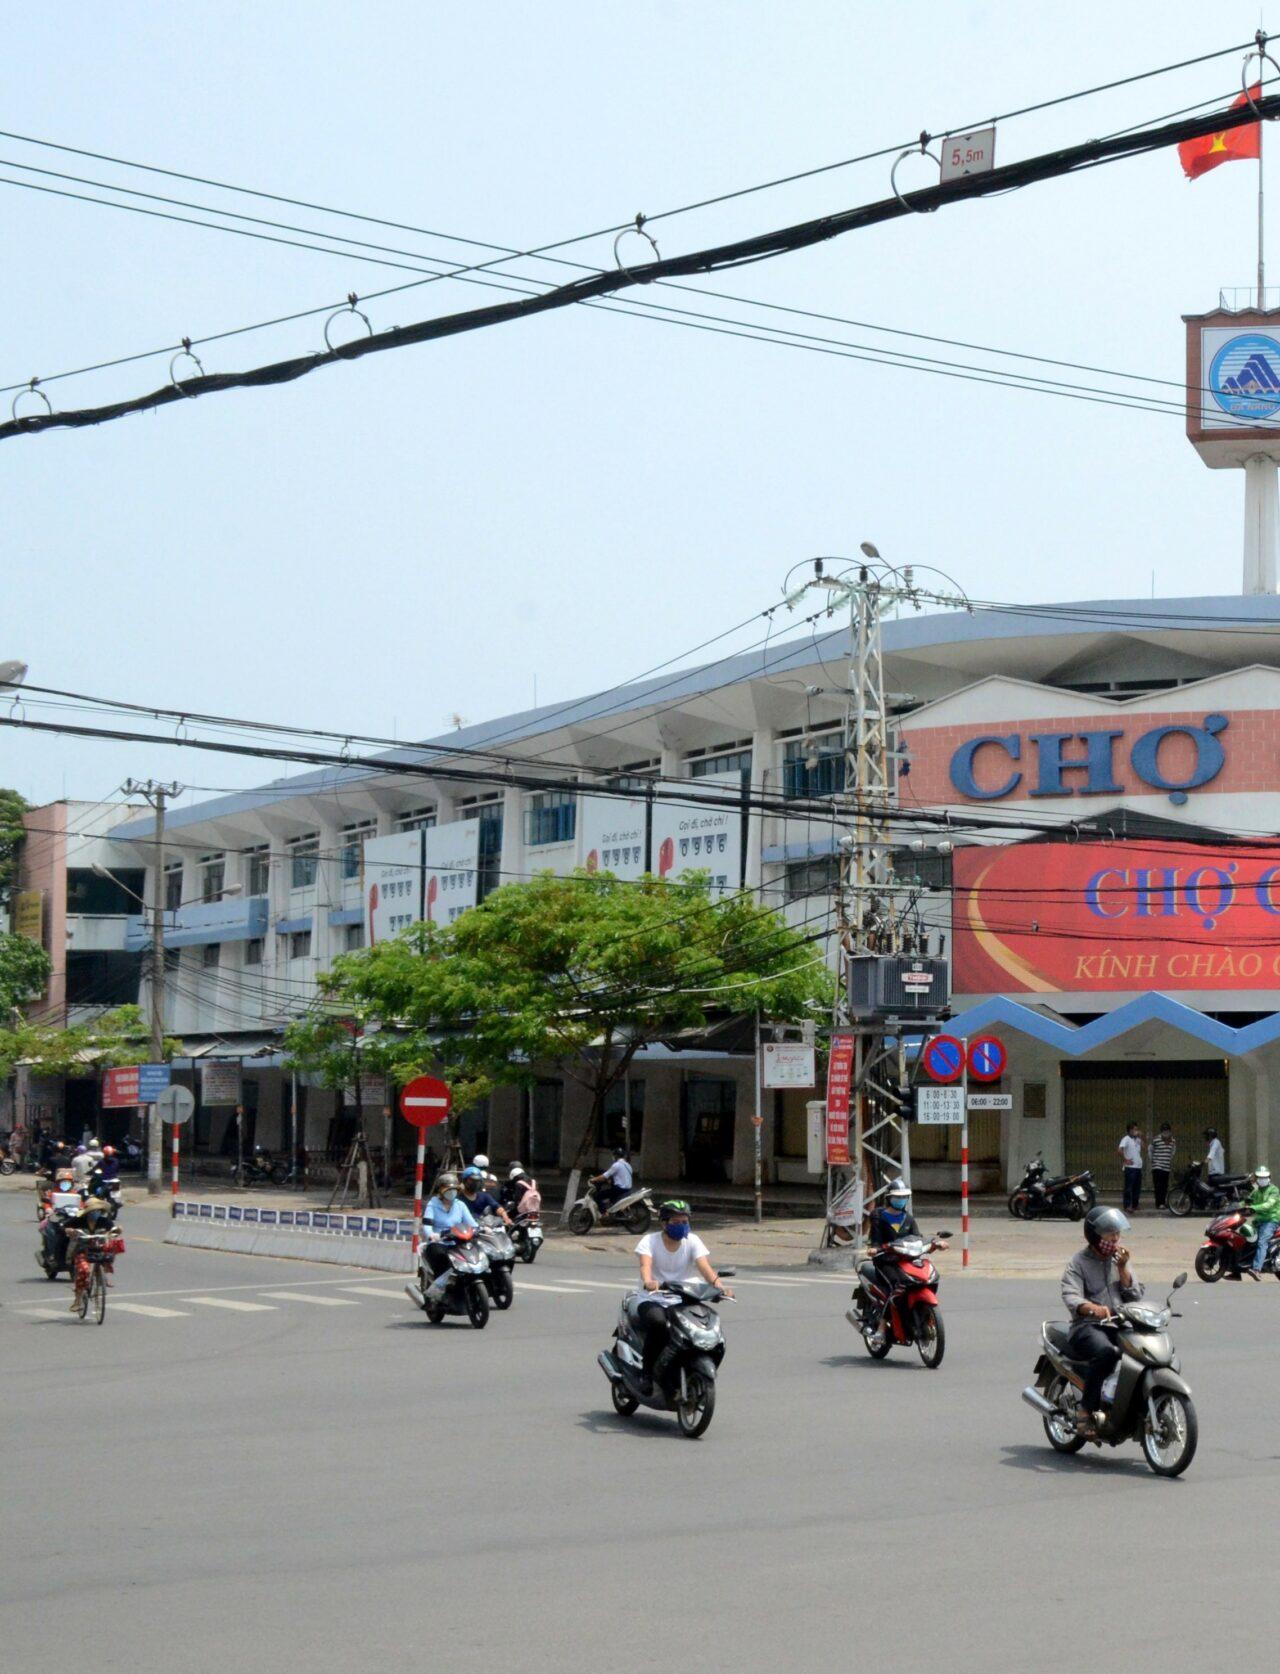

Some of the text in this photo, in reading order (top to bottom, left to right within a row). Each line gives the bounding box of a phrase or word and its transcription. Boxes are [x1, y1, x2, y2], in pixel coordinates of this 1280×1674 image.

[952, 148, 984, 166] 5,5m
[949, 713, 1229, 805] CHỢ
[1084, 862, 1239, 930] CHỢ
[1074, 949, 1160, 979] KÍNH
[1167, 947, 1262, 979] CHÀO
